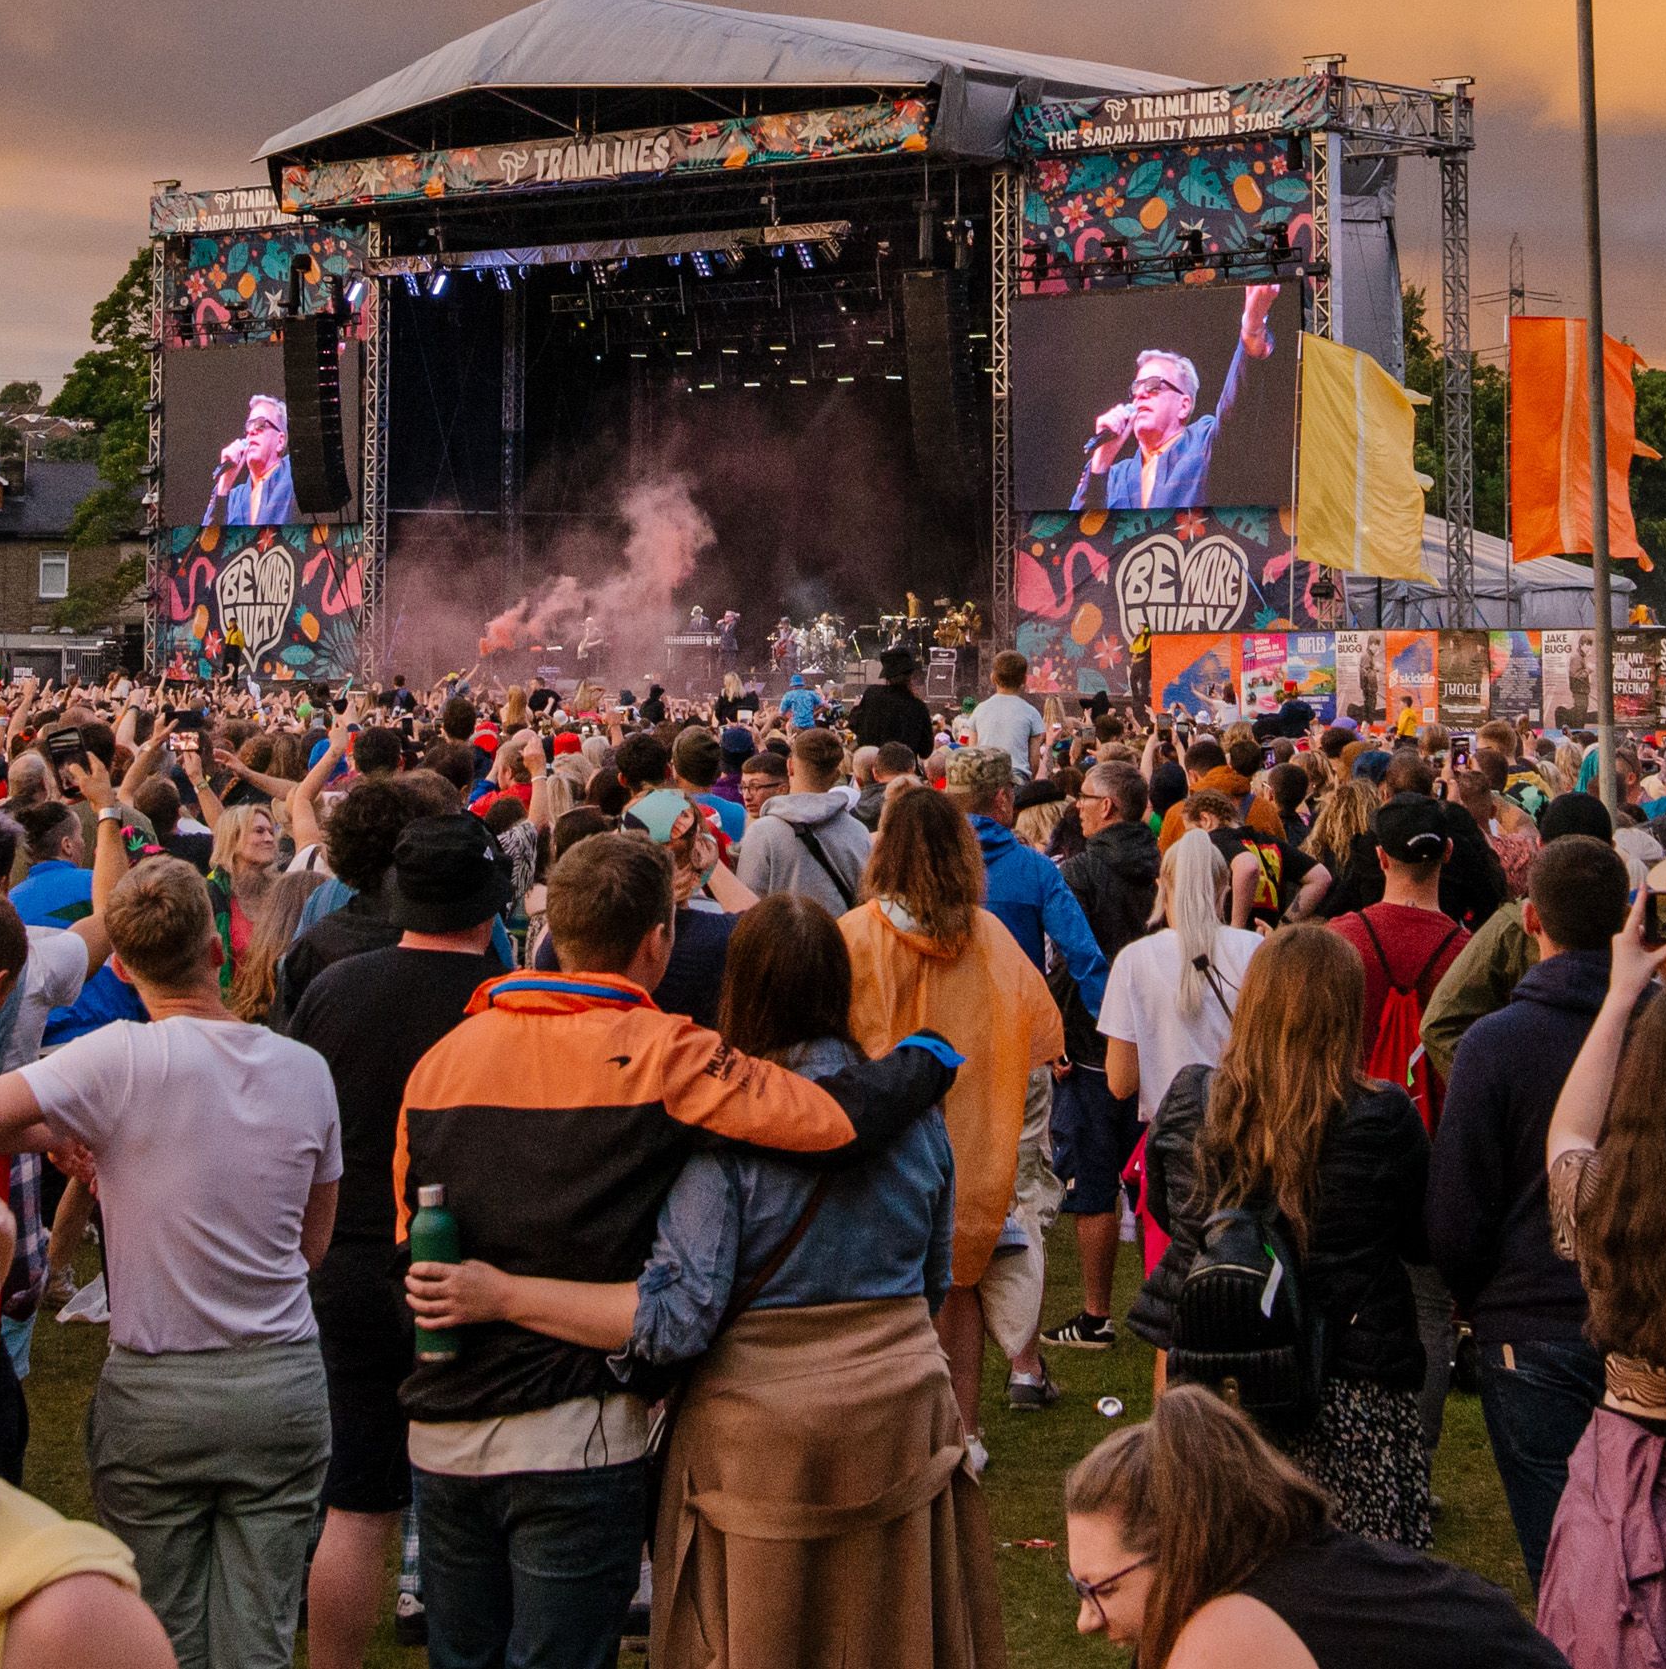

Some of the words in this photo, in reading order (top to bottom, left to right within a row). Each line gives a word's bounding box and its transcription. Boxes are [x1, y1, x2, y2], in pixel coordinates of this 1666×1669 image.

[1131, 90, 1230, 120] TRAMLINES
[1045, 129, 1078, 151] THE
[1082, 123, 1134, 148] SARAH
[1137, 118, 1186, 142] NULTY
[1189, 115, 1229, 139] MAIN
[1234, 110, 1284, 134] STAGE
[533, 134, 671, 183] TRAMLINES
[175, 217, 197, 233] THE
[199, 212, 233, 232] SARAH
[235, 210, 268, 230] NULTY
[222, 558, 255, 606] BE
[256, 553, 291, 604] MORE
[1124, 545, 1177, 605] BE
[1183, 544, 1239, 606] MORE
[1337, 633, 1358, 644] JAKE
[1337, 644, 1363, 654] BUGG
[1544, 633, 1568, 644] JAKE
[1544, 643, 1573, 654] BUGG
[1399, 671, 1436, 685] skiddle
